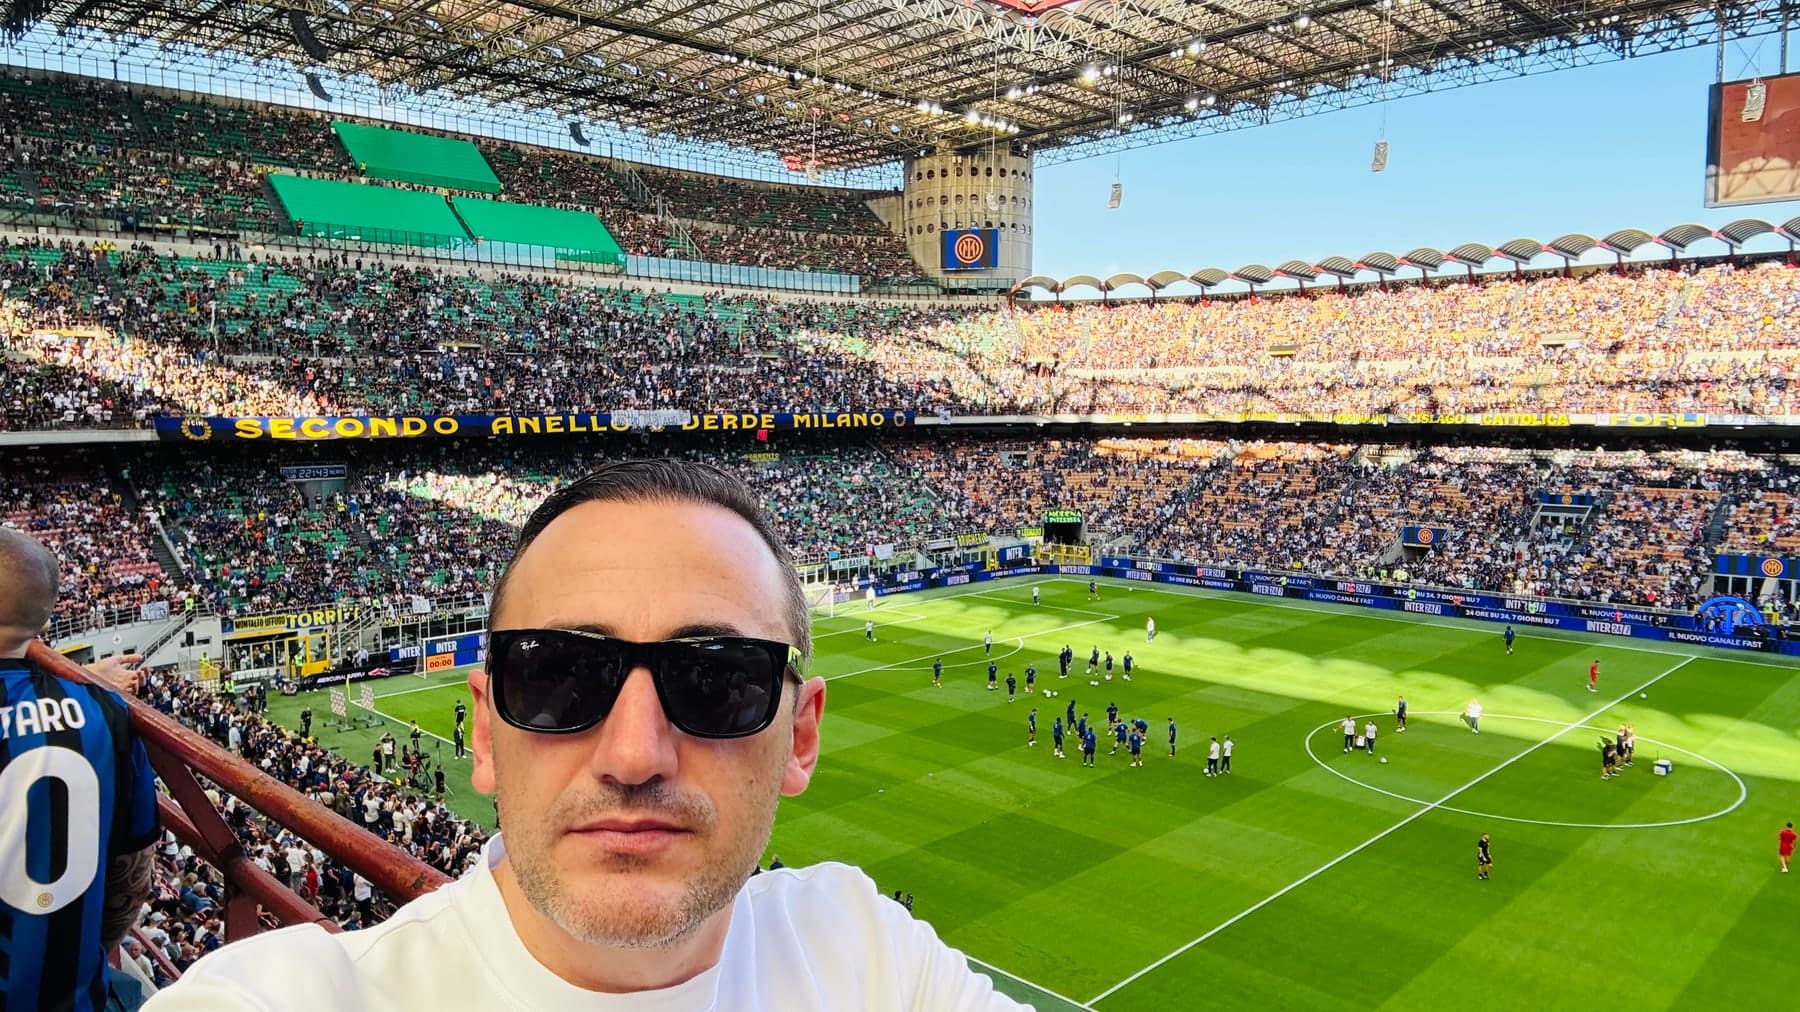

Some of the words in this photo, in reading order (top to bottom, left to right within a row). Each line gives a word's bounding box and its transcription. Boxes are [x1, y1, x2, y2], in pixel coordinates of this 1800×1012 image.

[1482, 413, 1570, 425] CATTOLICA
[234, 416, 460, 439] SECONDO
[793, 412, 885, 429] MILANO
[1252, 584, 1269, 595] INTER
[1360, 597, 1374, 605] FAST
[1404, 601, 1424, 613] INTER
[1517, 615, 1543, 623] GIORNI
[1586, 621, 1610, 634] INTER
[1669, 631, 1675, 639] IL
[1677, 632, 1706, 642] NUOVO
[1708, 635, 1740, 646] CANALE
[1742, 639, 1762, 649] FAST
[399, 646, 421, 659] INTER
[436, 641, 457, 654] INTER
[429, 659, 452, 669] 00:00
